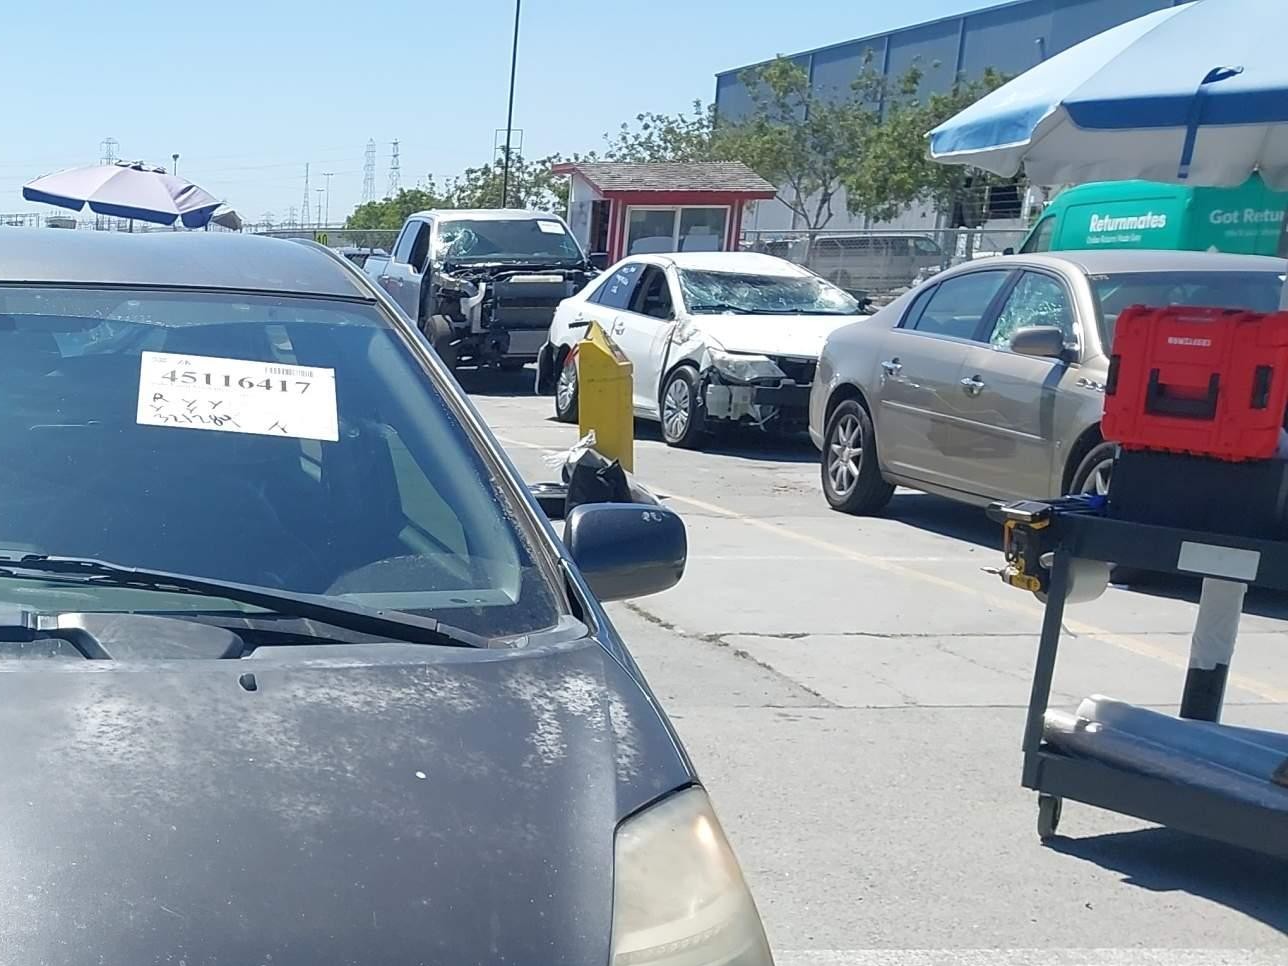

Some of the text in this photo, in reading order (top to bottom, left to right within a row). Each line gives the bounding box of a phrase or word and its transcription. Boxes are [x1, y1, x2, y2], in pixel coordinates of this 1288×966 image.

[1089, 212, 1166, 231] Returnmates
[1209, 209, 1240, 224] Got
[161, 370, 311, 394] 45116417
